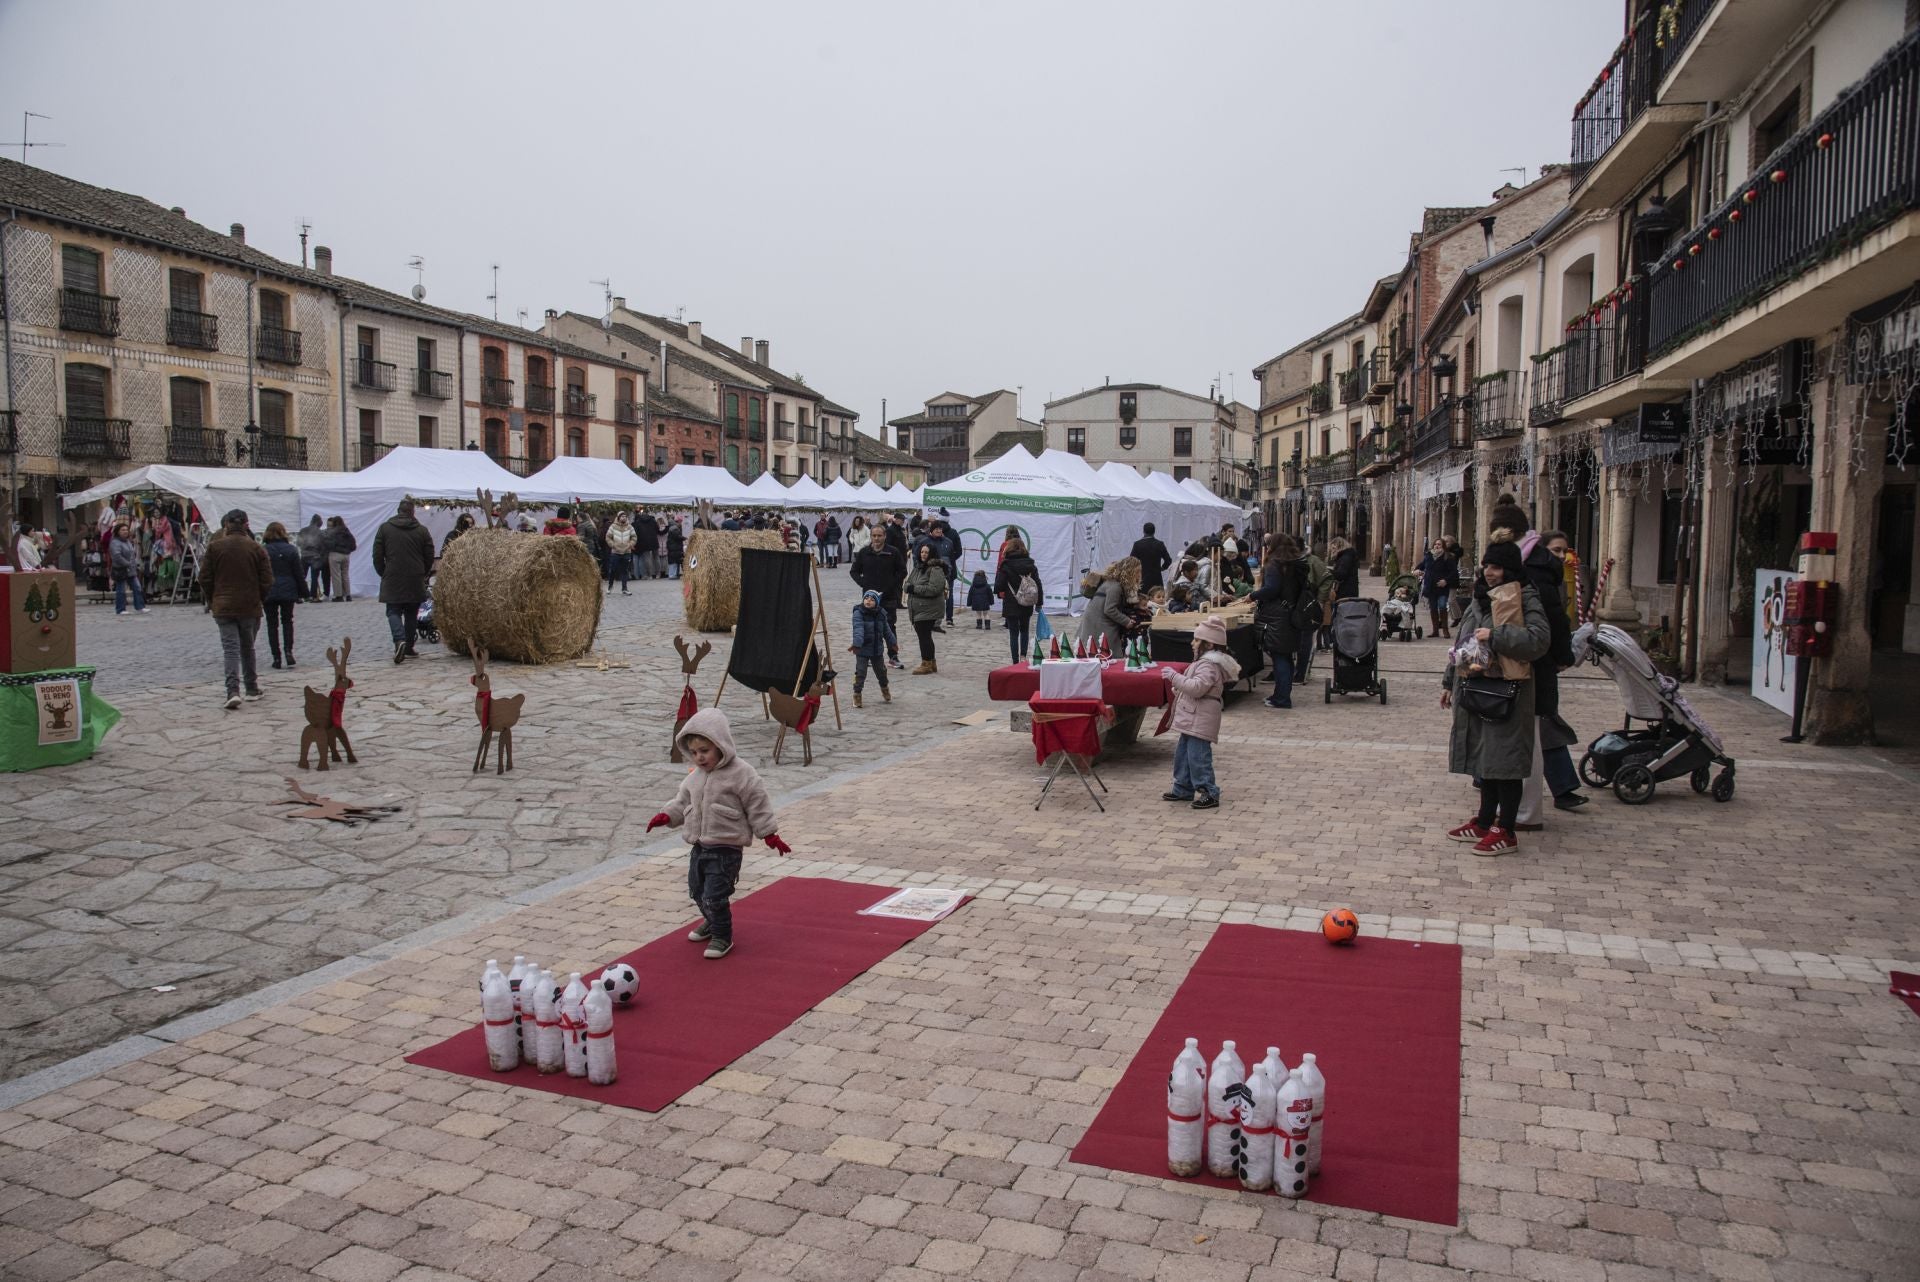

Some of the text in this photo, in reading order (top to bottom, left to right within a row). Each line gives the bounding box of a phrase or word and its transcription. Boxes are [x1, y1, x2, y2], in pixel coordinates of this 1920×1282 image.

[927, 495, 968, 504] ASOCIACIÓN
[968, 496, 1003, 505] ESPAÑOLA
[1004, 498, 1034, 507] CONTRA
[1043, 500, 1073, 510] CÁNCER
[41, 685, 72, 694] RODOLFO
[53, 692, 71, 700] RENO
